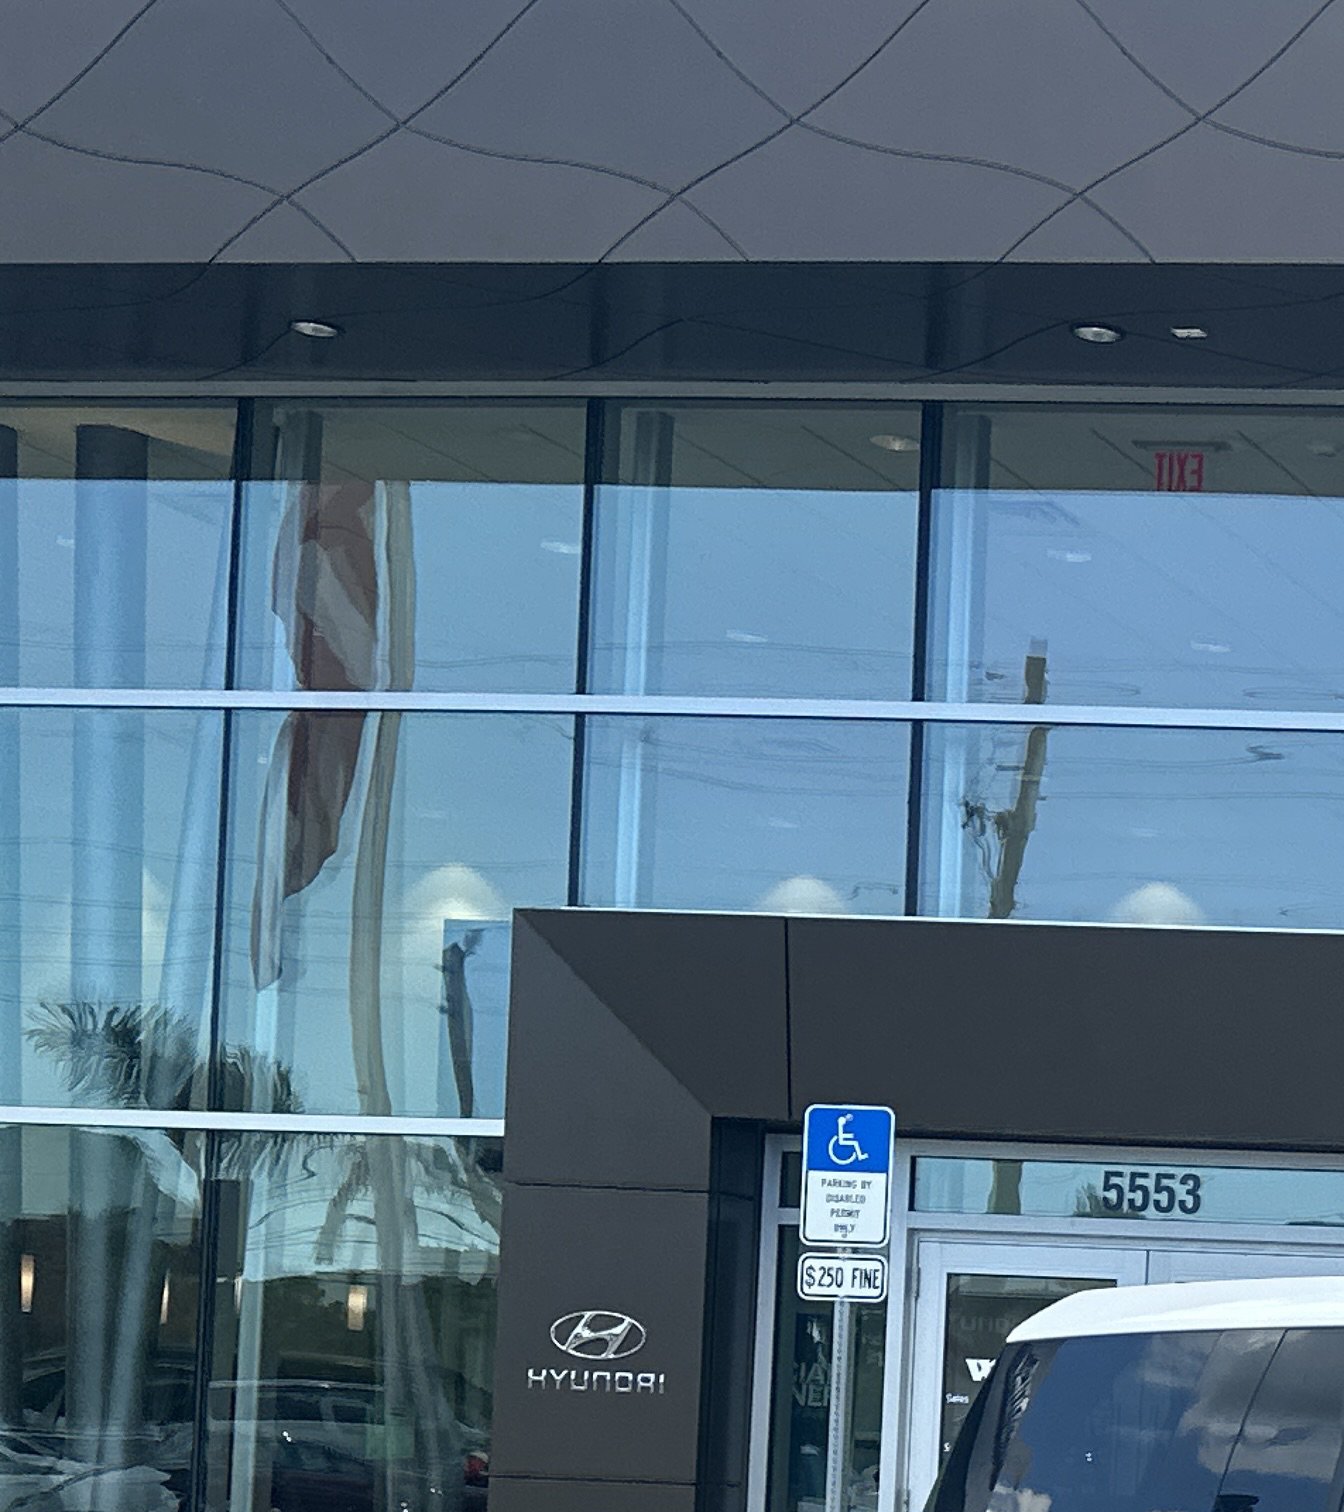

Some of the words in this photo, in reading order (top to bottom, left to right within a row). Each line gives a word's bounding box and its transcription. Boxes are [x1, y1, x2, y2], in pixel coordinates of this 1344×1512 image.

[1102, 1170, 1201, 1215] 5553
[804, 1264, 844, 1290] $250
[850, 1266, 880, 1290] FINE
[527, 1367, 665, 1395] HYUNDAI
